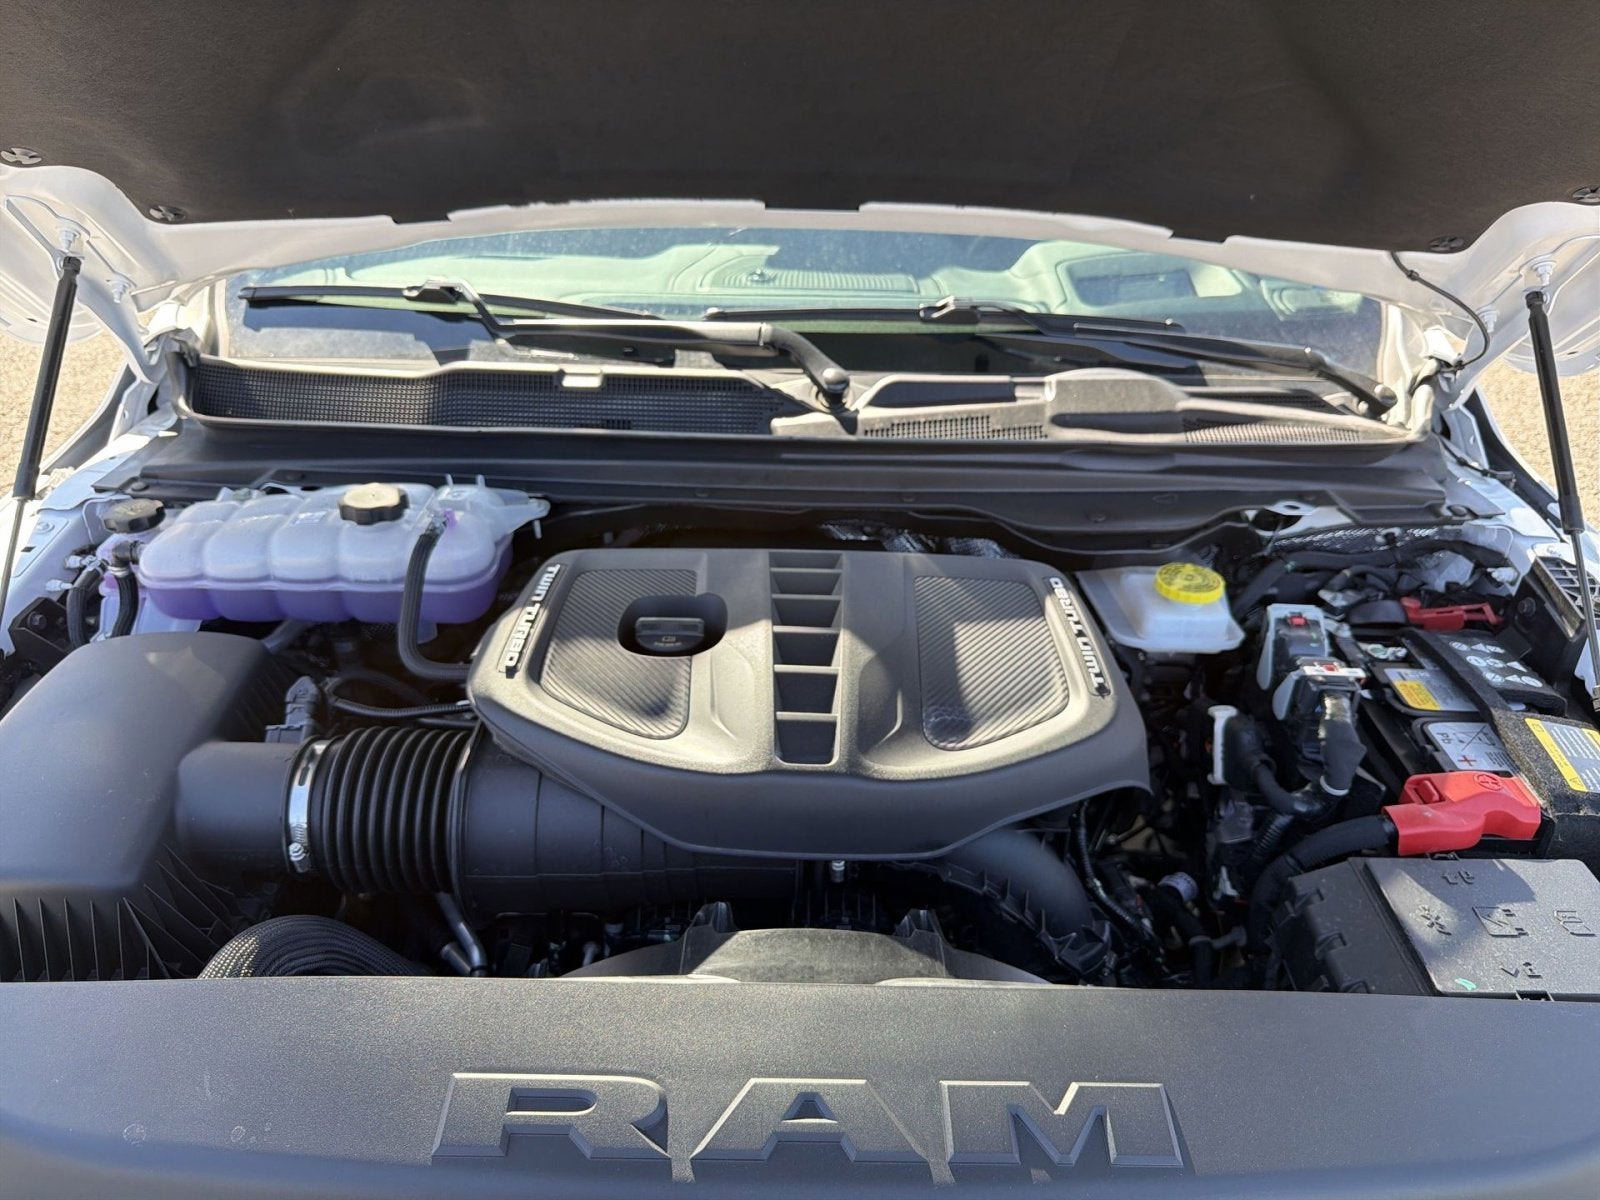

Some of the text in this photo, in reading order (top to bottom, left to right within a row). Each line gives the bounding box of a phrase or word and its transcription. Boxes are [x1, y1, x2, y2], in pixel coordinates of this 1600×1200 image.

[504, 563, 561, 667] TWIN TURBO
[1049, 577, 1105, 688] TWIN TURBO
[431, 1072, 1184, 1168] RAM
